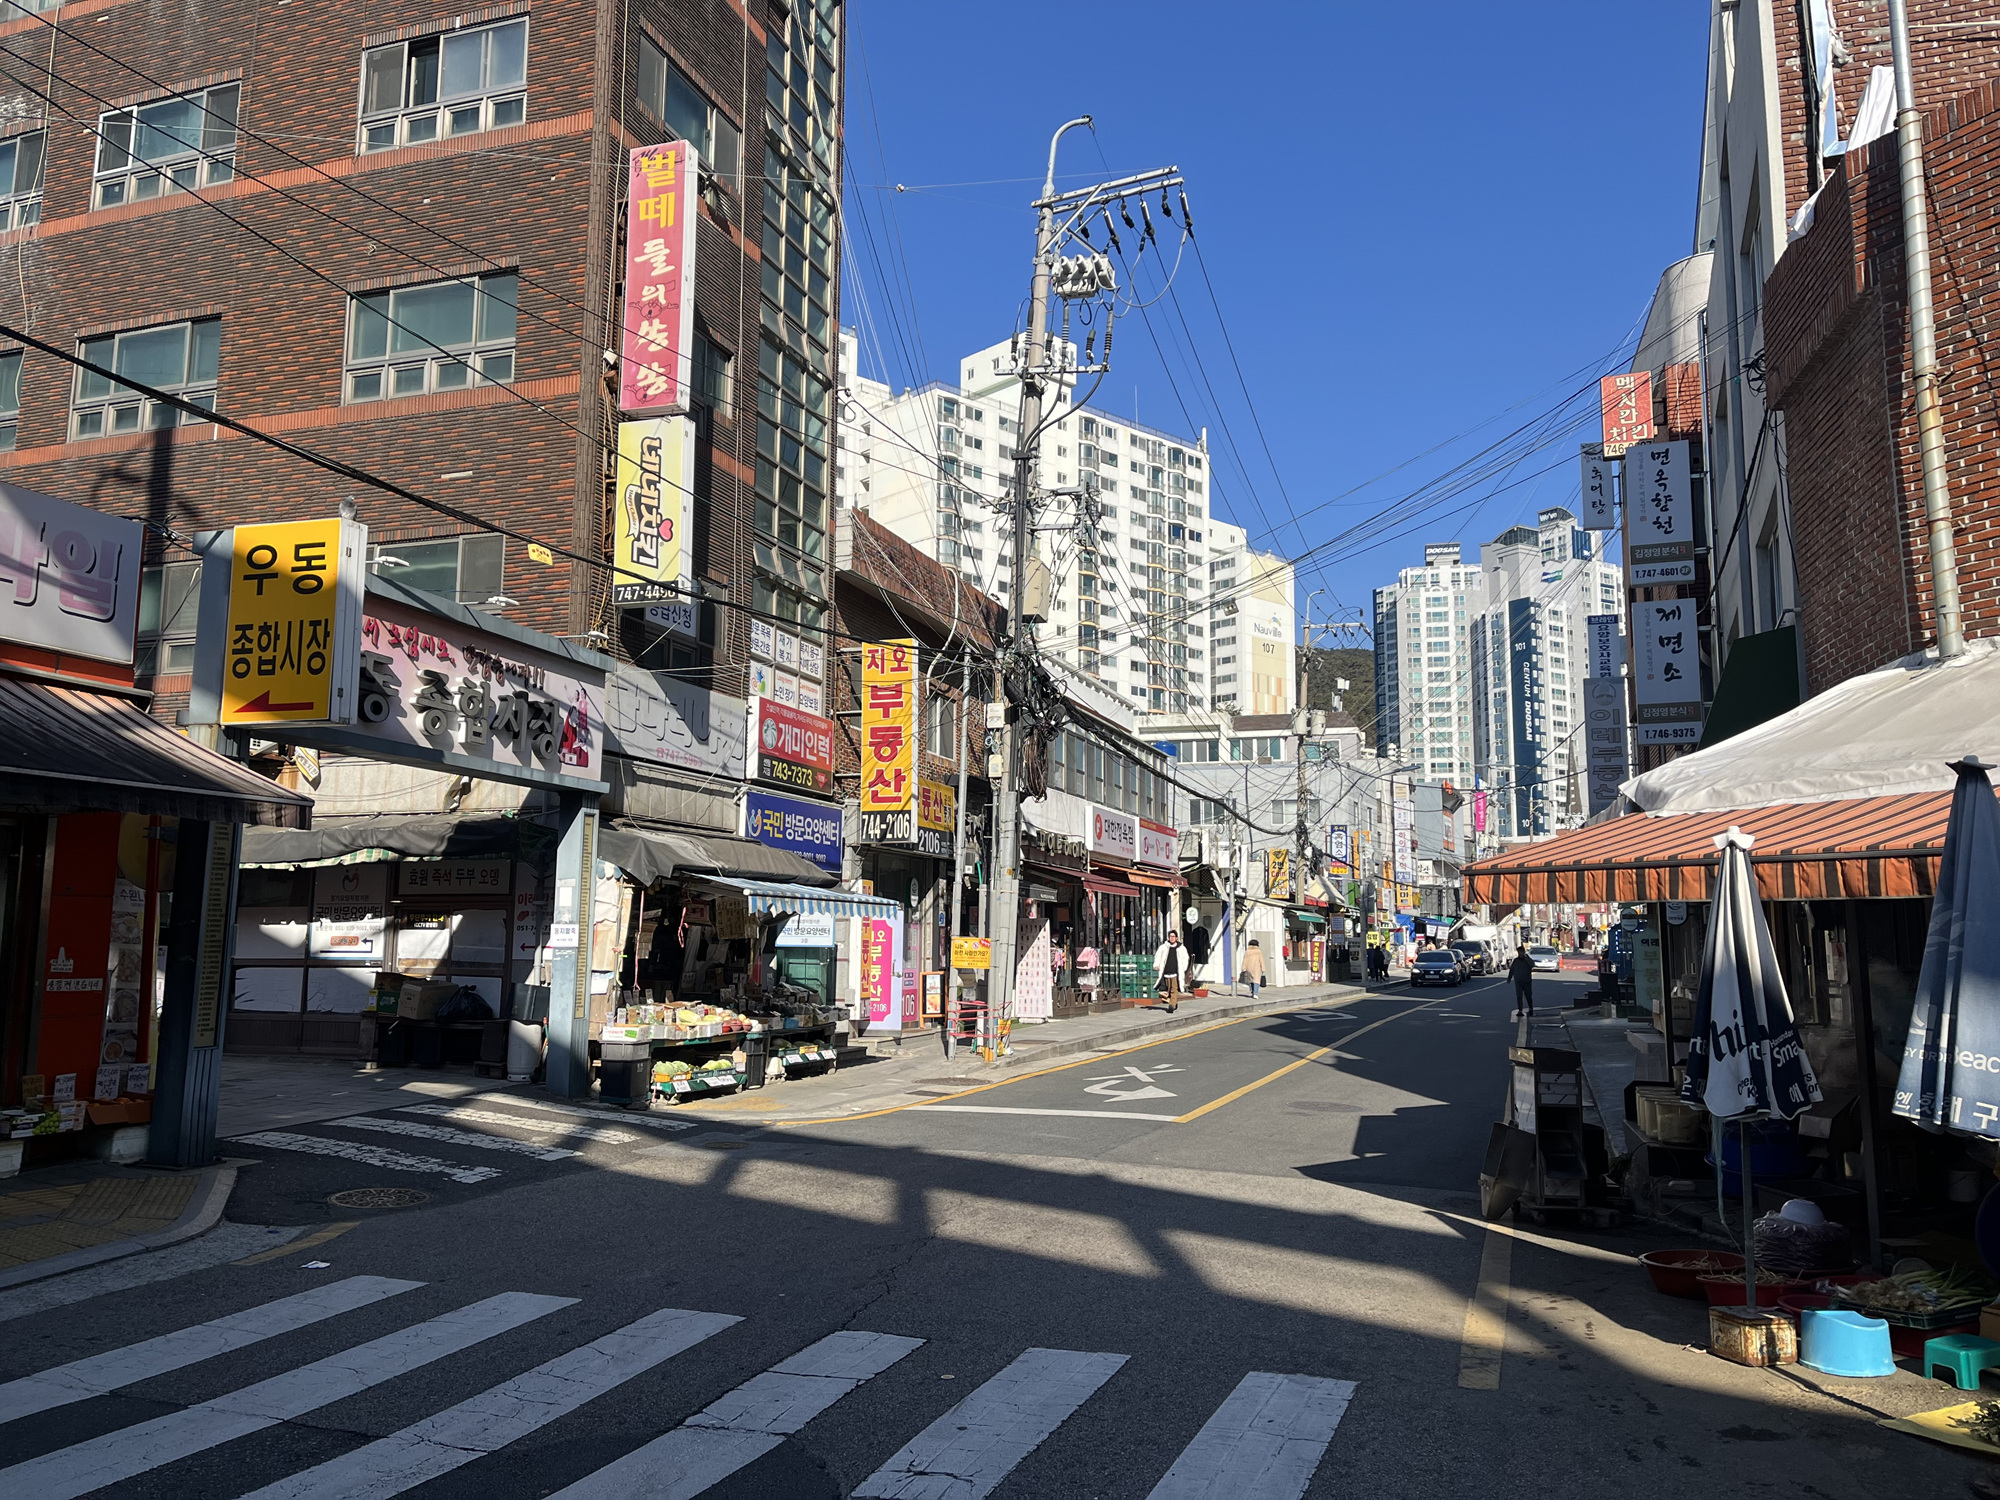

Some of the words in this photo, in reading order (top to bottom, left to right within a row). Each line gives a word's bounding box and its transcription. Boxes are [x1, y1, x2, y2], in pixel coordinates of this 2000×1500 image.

[1615, 376, 1639, 424] 멕시칸
[1609, 424, 1648, 442] 치킨
[631, 436, 663, 569] 네네치킨
[1590, 466, 1606, 515] 추어탕
[1650, 447, 1674, 535] 면옥향천
[1426, 546, 1461, 554] DOOSAN
[243, 542, 327, 596] 우동
[1635, 567, 1680, 579] T.747-4601
[363, 617, 381, 648] 서
[1254, 622, 1282, 638] Nauville
[1656, 605, 1685, 682] 제면소
[232, 618, 331, 680] 종합시장
[867, 646, 909, 675] 지오
[1262, 643, 1275, 654] 107
[1515, 642, 1526, 651] 101
[1523, 661, 1531, 698] CENTUM
[409, 669, 565, 760] 종합시장
[1525, 701, 1533, 741] DOOSAN
[1642, 706, 1687, 718] 김정영분식
[778, 722, 830, 766] 개미인력
[868, 684, 907, 804] 부동산
[1645, 727, 1696, 740] T.746-9375
[772, 760, 813, 787] 743-7373
[918, 785, 943, 824] 동산
[763, 809, 784, 839] 국민
[785, 813, 840, 848] 방문요양센터
[862, 814, 910, 841] 744-2106
[1522, 819, 1530, 828] 10
[1335, 833, 1344, 856] 흑염소
[409, 868, 428, 886] 효원
[431, 868, 451, 886] 즉석
[455, 868, 475, 886] 두부
[478, 868, 500, 886] 오뎅
